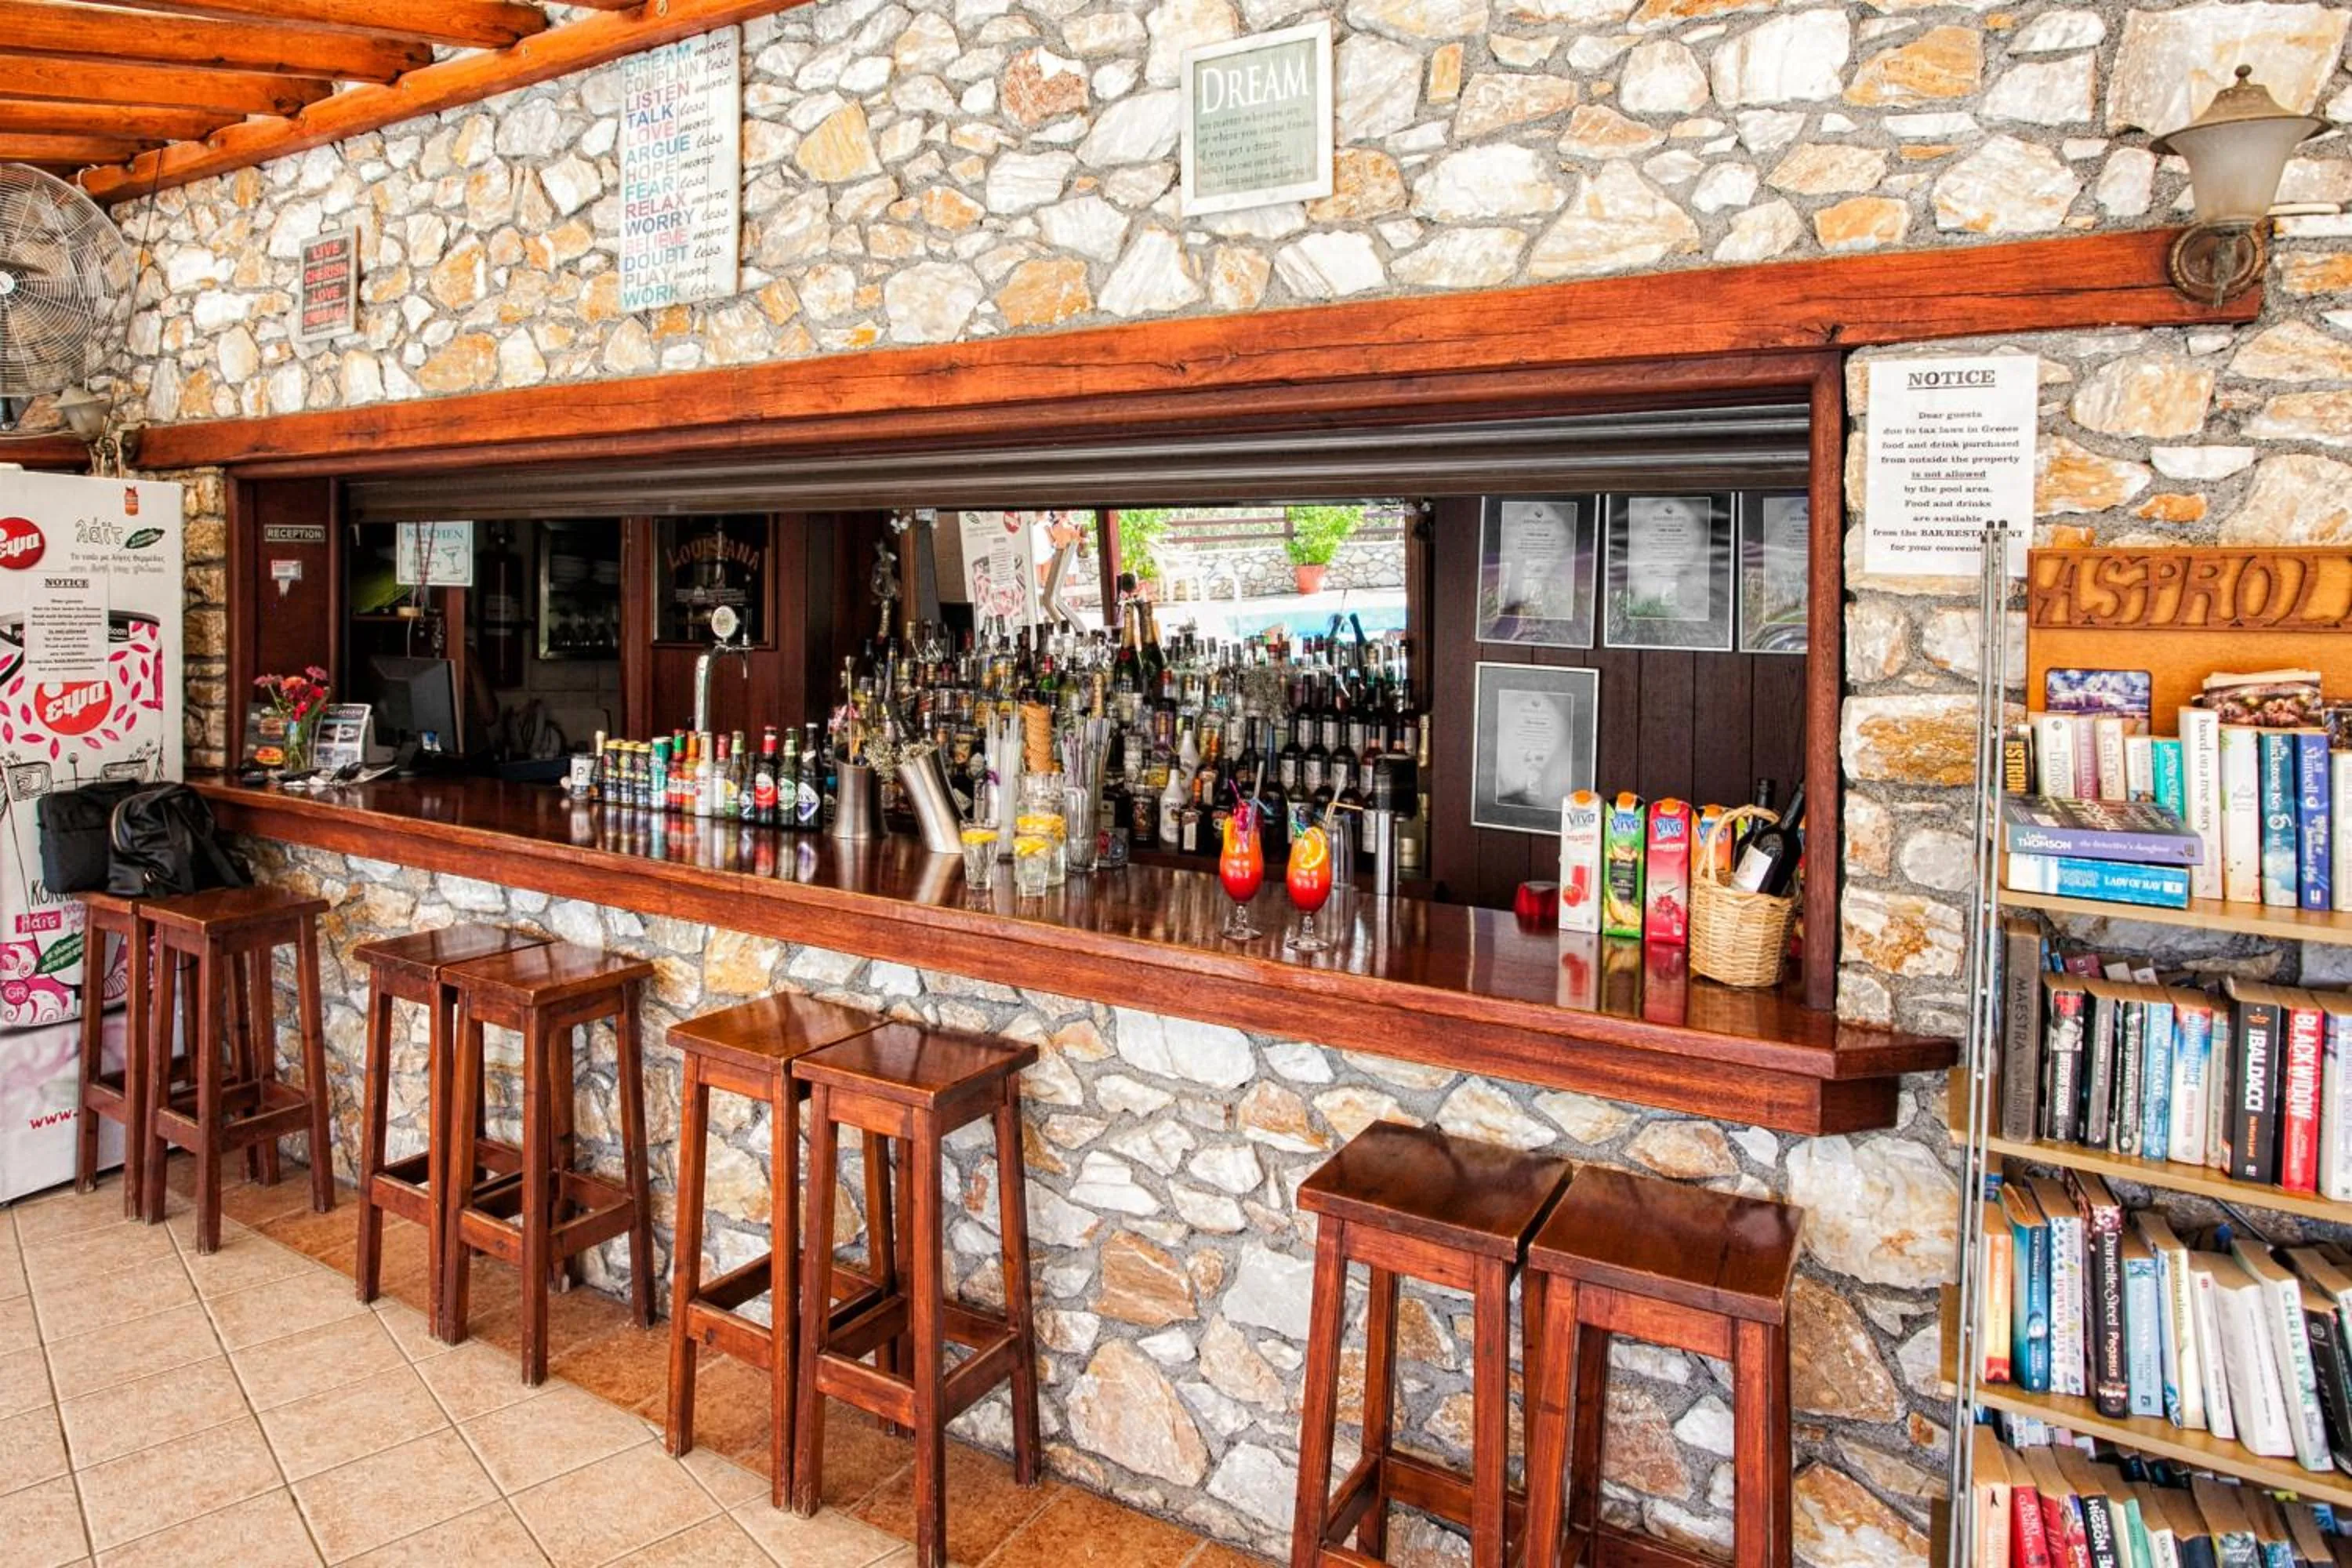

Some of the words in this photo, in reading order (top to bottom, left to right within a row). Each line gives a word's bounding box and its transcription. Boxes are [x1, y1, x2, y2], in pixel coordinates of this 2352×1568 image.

[625, 44, 690, 77] DREAM
[626, 81, 689, 112] LISTEN
[1200, 55, 1309, 114] DREAM
[626, 103, 673, 129] TALK
[627, 121, 675, 147] LOVE
[626, 135, 690, 167] ARGUE
[626, 156, 677, 184] HOPE
[625, 176, 674, 203] FEAR
[625, 189, 686, 220] RELAX
[624, 208, 695, 237] WORRY
[623, 244, 689, 272] DOUBT
[624, 267, 672, 289] PLAY
[622, 284, 680, 308] WORK
[1907, 370, 1996, 388] NOTICE
[1918, 411, 1944, 419] Dear
[1929, 440, 1959, 448] drink
[1962, 440, 2020, 449] purchased
[1909, 455, 1948, 463] outside
[1951, 455, 1969, 463] the
[1972, 455, 2020, 464] property
[1945, 470, 1987, 478] allowed
[1904, 485, 1916, 494] by
[1919, 485, 1936, 493] the
[1939, 485, 1962, 495] pool
[1956, 499, 1992, 508] drinks
[267, 528, 322, 539] RECEPTION
[405, 527, 464, 539] KTCHEN
[1900, 528, 1918, 537] the
[1907, 544, 1933, 553] your
[45, 578, 89, 588] NOTICE
[2198, 719, 2211, 751] based
[2198, 754, 2208, 768] on
[2303, 746, 2319, 793] Mansell
[2199, 779, 2210, 801] true
[2268, 793, 2281, 811] Key
[2199, 804, 2213, 833] story
[2016, 837, 2072, 851] THOMSON
[5, 987, 27, 1000] GR
[2013, 978, 2028, 1051] MAESTRA
[2292, 1014, 2317, 1065] BLACK
[2245, 1036, 2267, 1112] BALDACCI
[2289, 1065, 2315, 1121] WIDOW
[2104, 1232, 2118, 1288] Danielle
[2103, 1288, 2120, 1326] Steel
[2104, 1330, 2119, 1377] Pegasus
[2284, 1290, 2303, 1350] CHRIS
[2296, 1355, 2316, 1406] RYAN
[2087, 1499, 2108, 1551] HIGSON
